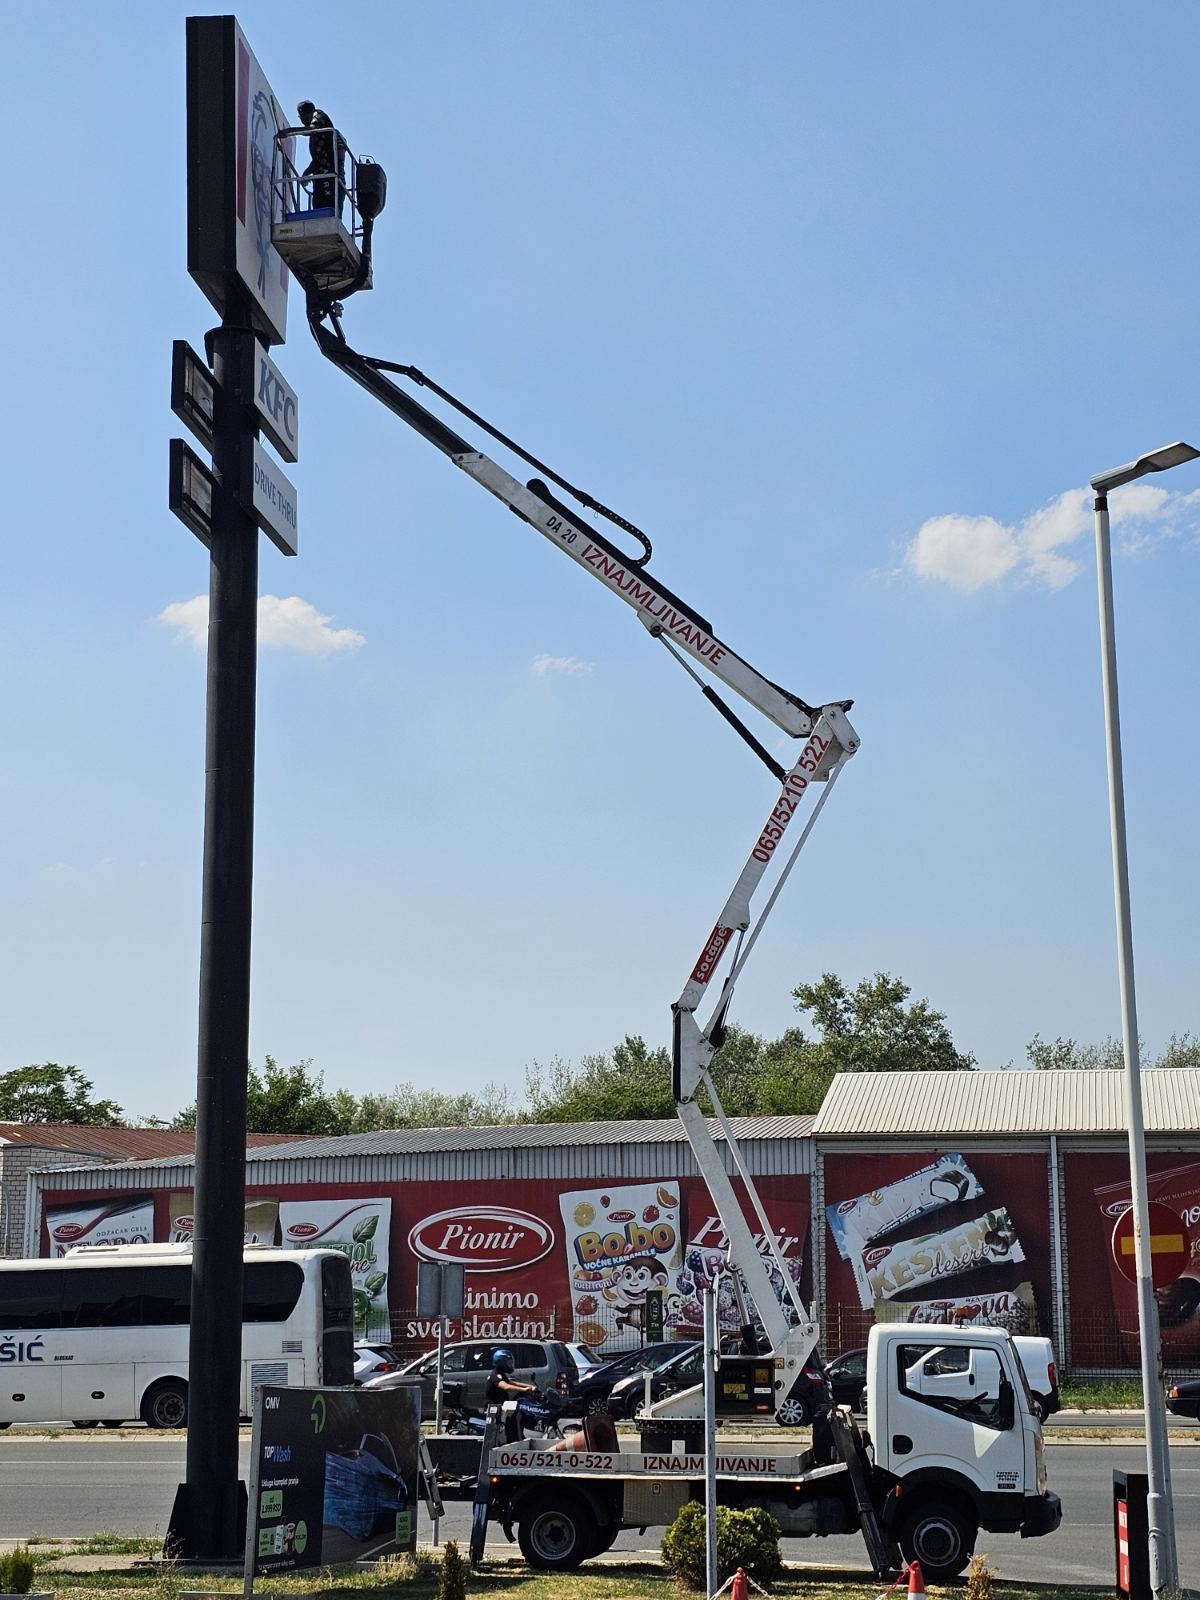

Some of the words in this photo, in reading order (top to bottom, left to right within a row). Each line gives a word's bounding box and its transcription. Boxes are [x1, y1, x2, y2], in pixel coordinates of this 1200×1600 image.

[258, 358, 296, 442] KFC
[254, 462, 277, 506] DRIVE
[277, 489, 297, 529] THRU
[545, 516, 561, 534] DA
[562, 528, 577, 544] 20
[580, 544, 727, 667] IZNAJMLJIVANJE
[752, 774, 808, 863] 065/5210
[799, 735, 830, 773] 522
[696, 926, 728, 980] socage
[438, 1224, 525, 1250] Pionir
[574, 1222, 675, 1264] Bobo
[612, 1248, 657, 1263] KARAMELE
[931, 1241, 993, 1278] desert
[265, 1397, 280, 1409] OMV
[264, 1446, 275, 1459] TOP
[501, 1453, 613, 1470] 065/521-0-522
[643, 1456, 778, 1473] IZNAJMJIVANJE
